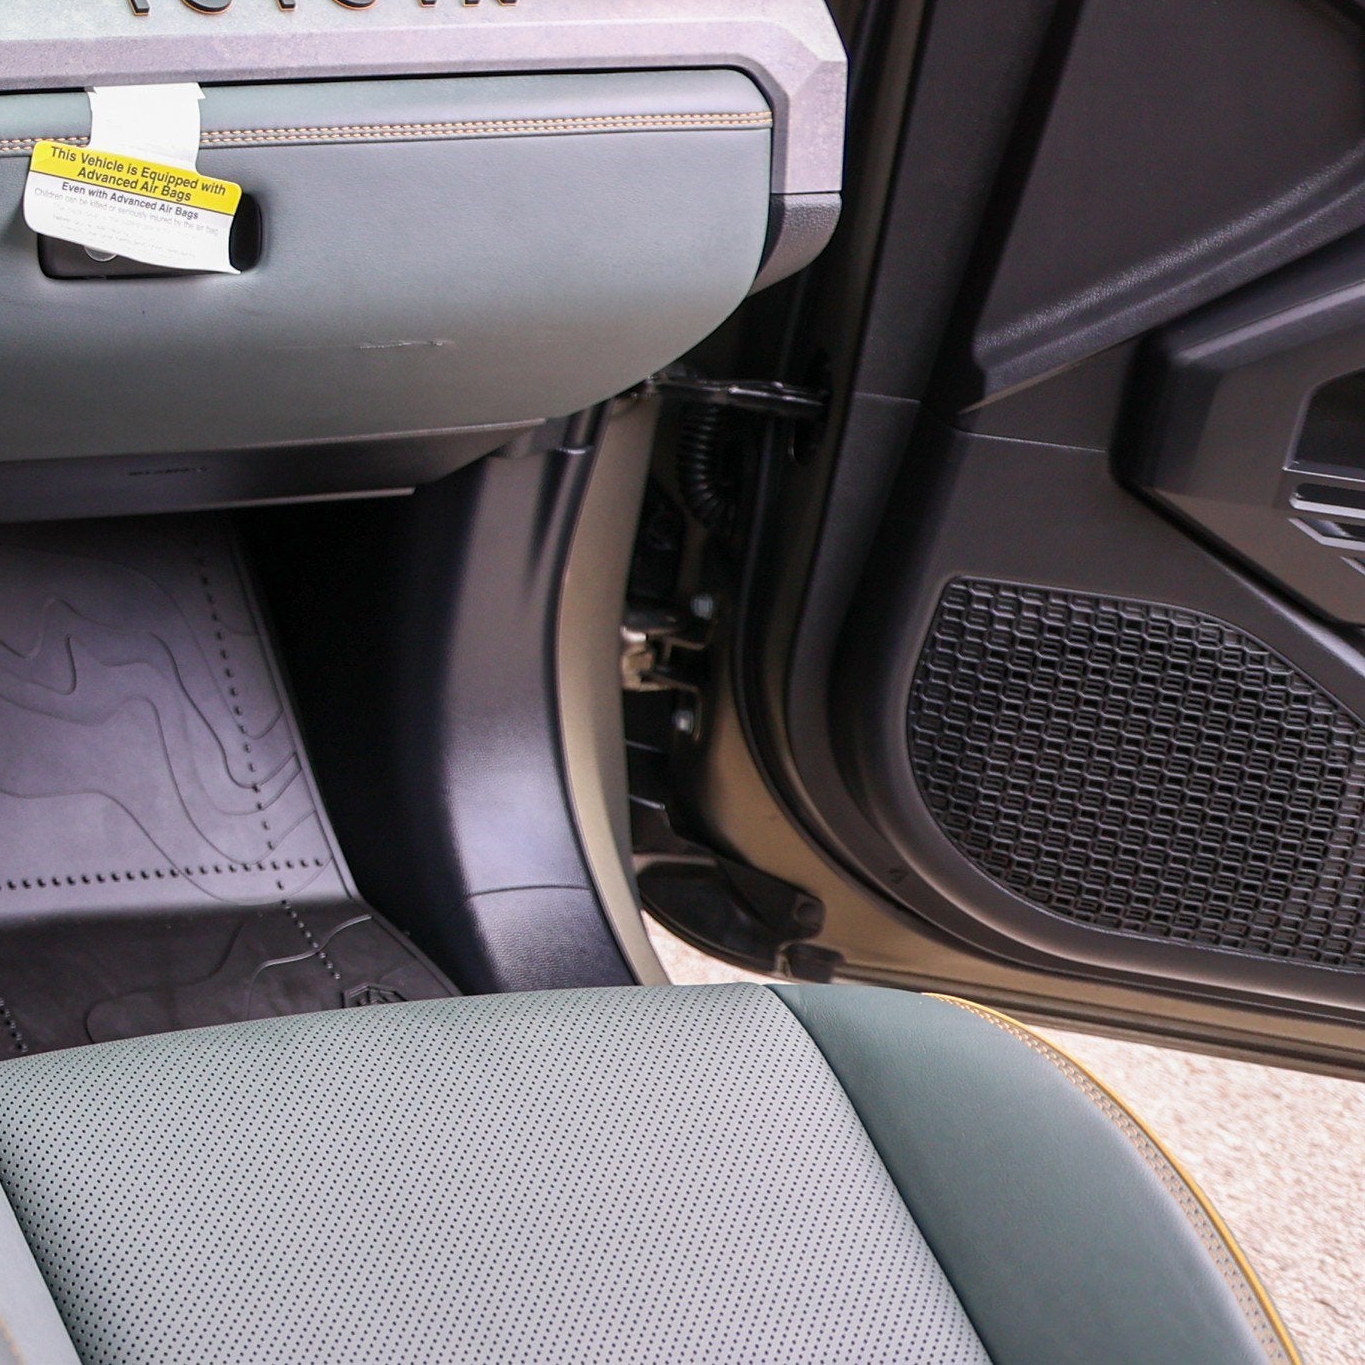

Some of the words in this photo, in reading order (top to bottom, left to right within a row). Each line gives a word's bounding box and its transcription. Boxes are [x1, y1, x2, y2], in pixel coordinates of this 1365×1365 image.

[50, 146, 77, 162] This
[81, 152, 124, 173] Vehicle
[127, 162, 139, 176] is
[140, 166, 199, 192] Equipped
[201, 179, 227, 196] with
[77, 166, 137, 189] Advanced
[139, 179, 158, 194] Air
[160, 183, 192, 203] Bags
[34, 187, 63, 201] Children
[61, 181, 86, 195] Even
[88, 188, 108, 200] with
[109, 192, 157, 212] Advanced
[158, 202, 173, 215] Air
[175, 204, 199, 220] Bags
